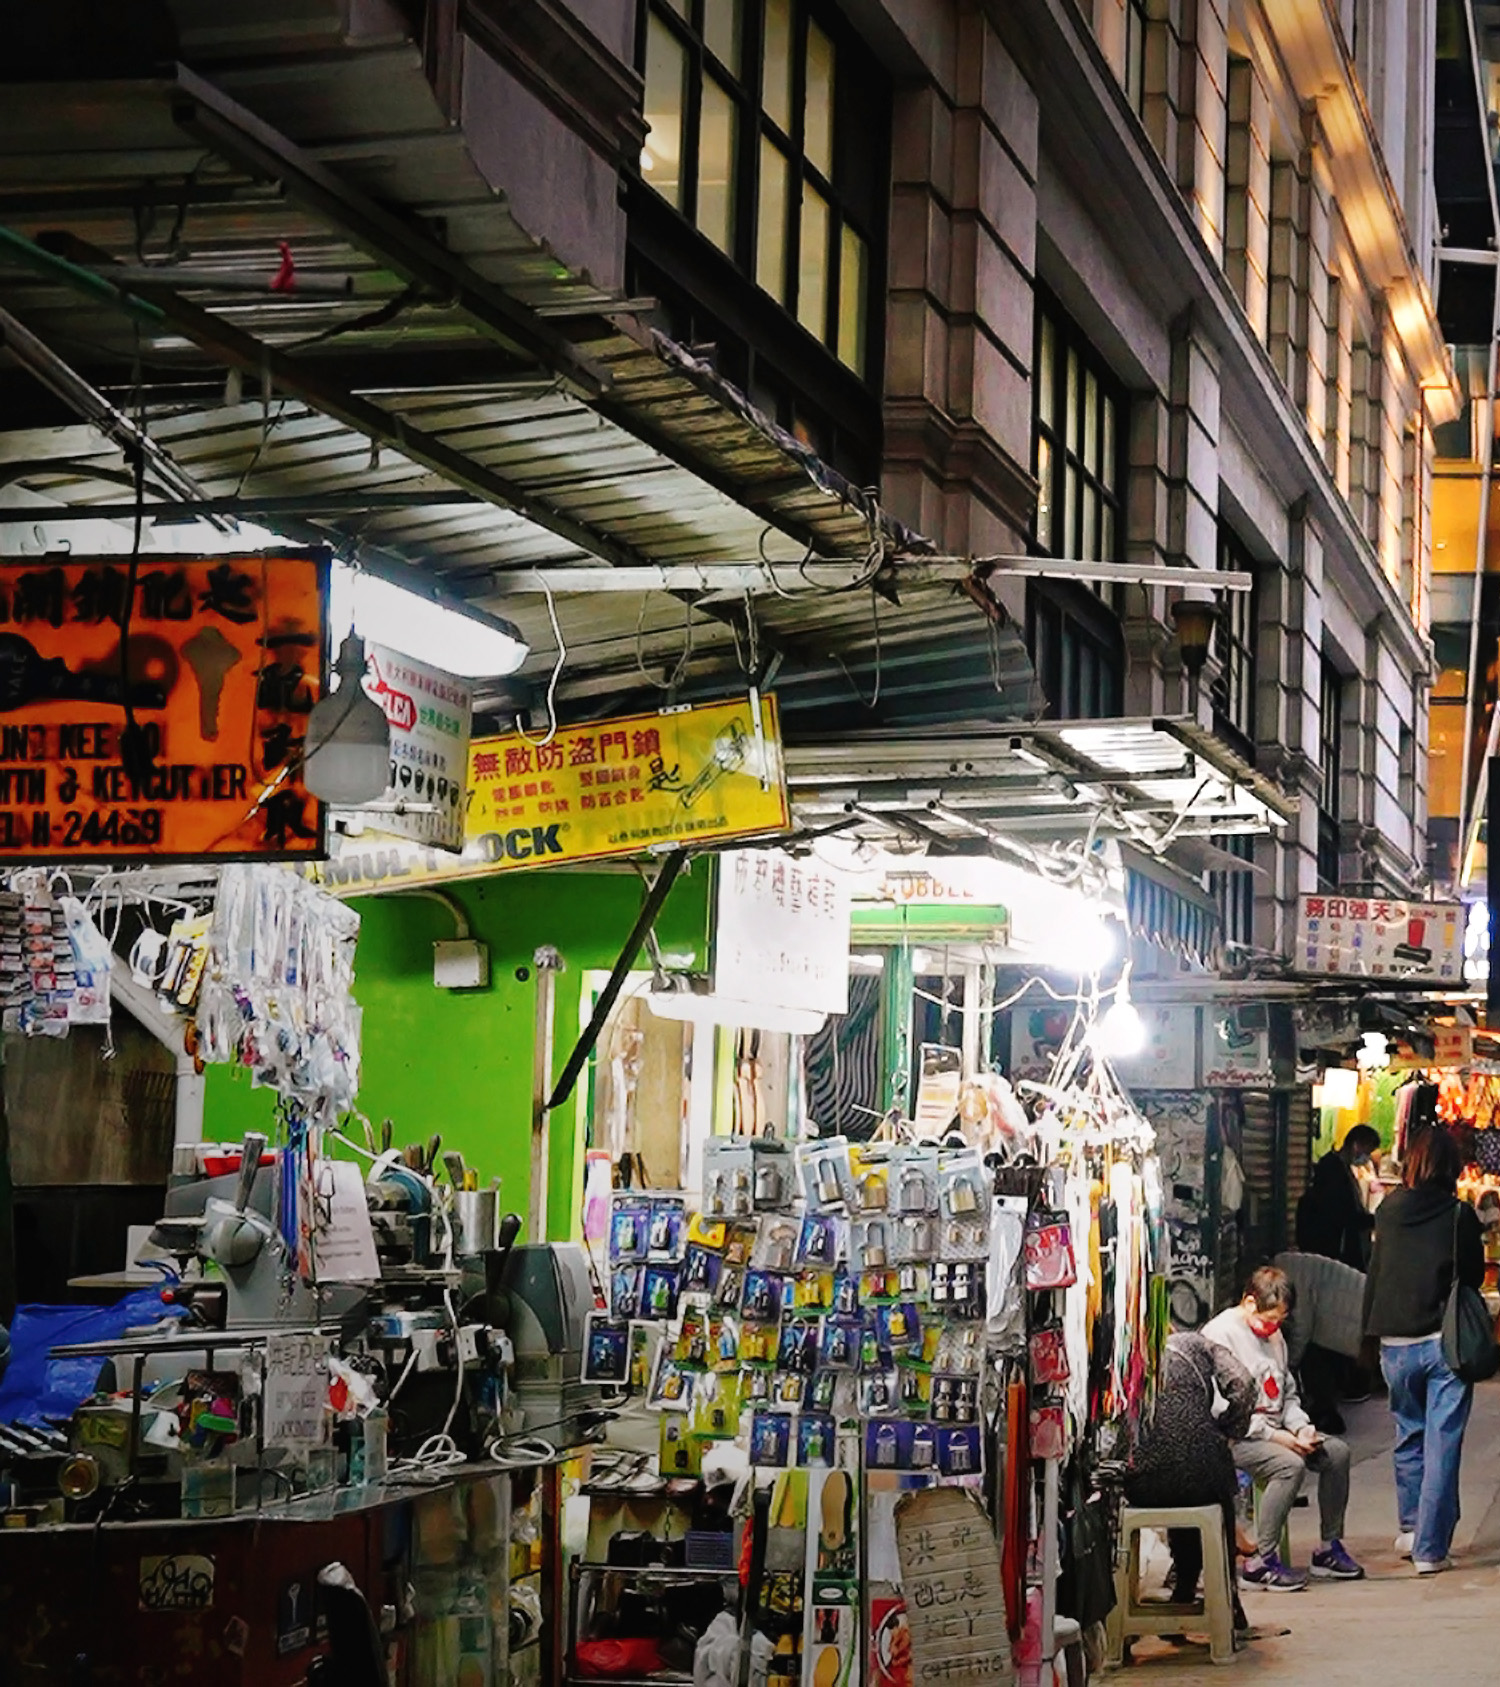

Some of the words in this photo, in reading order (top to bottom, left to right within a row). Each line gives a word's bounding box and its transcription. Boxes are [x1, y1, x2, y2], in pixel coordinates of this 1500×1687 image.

[59, 722, 112, 760] KEE
[473, 728, 661, 783] 無敵防盜門鎖
